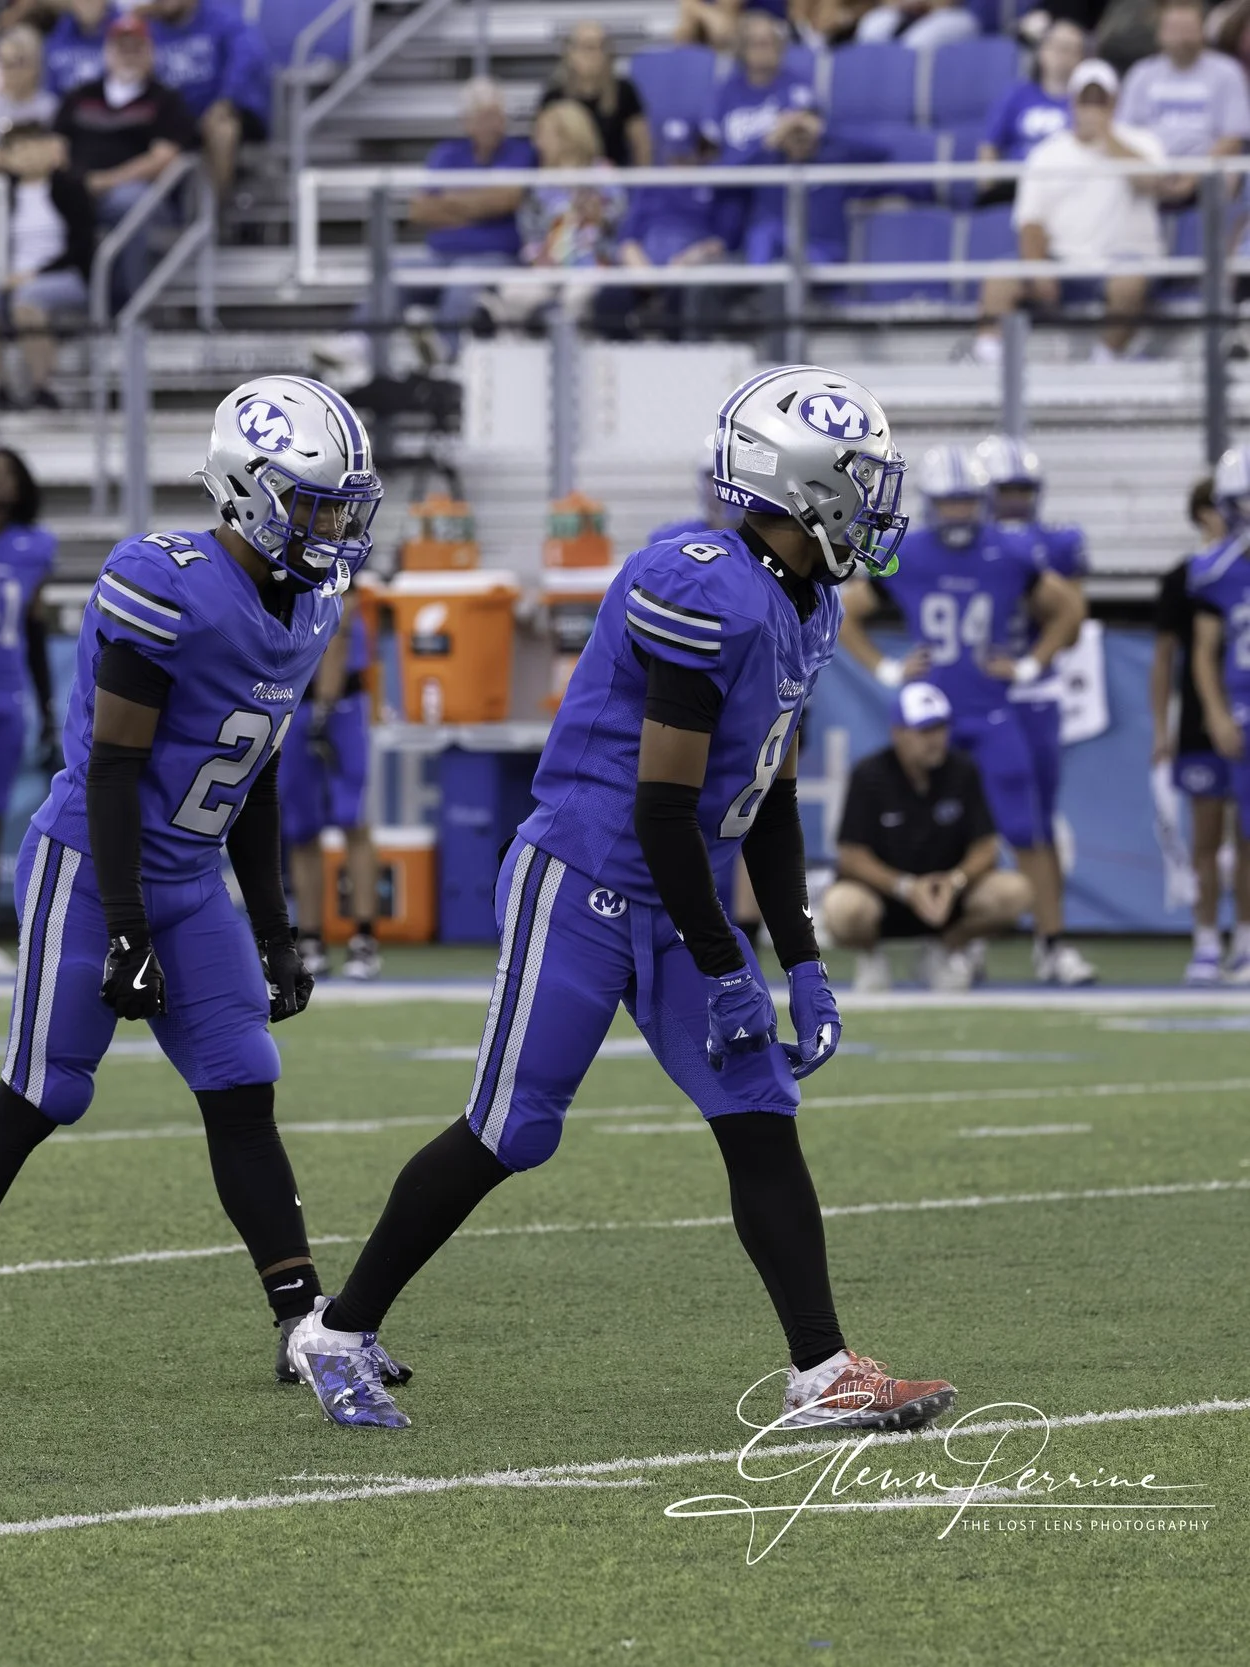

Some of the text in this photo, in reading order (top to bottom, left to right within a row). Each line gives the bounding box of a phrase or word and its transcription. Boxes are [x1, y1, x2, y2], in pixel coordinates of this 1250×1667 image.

[239, 401, 291, 450] M
[807, 396, 865, 438] M
[714, 486, 753, 507] WAY
[139, 533, 212, 569] 21
[680, 543, 729, 564] 8
[921, 592, 993, 667] 94
[252, 681, 294, 703] Vikings
[717, 709, 794, 840] 8
[594, 891, 622, 914] M
[837, 1380, 893, 1408] USA
